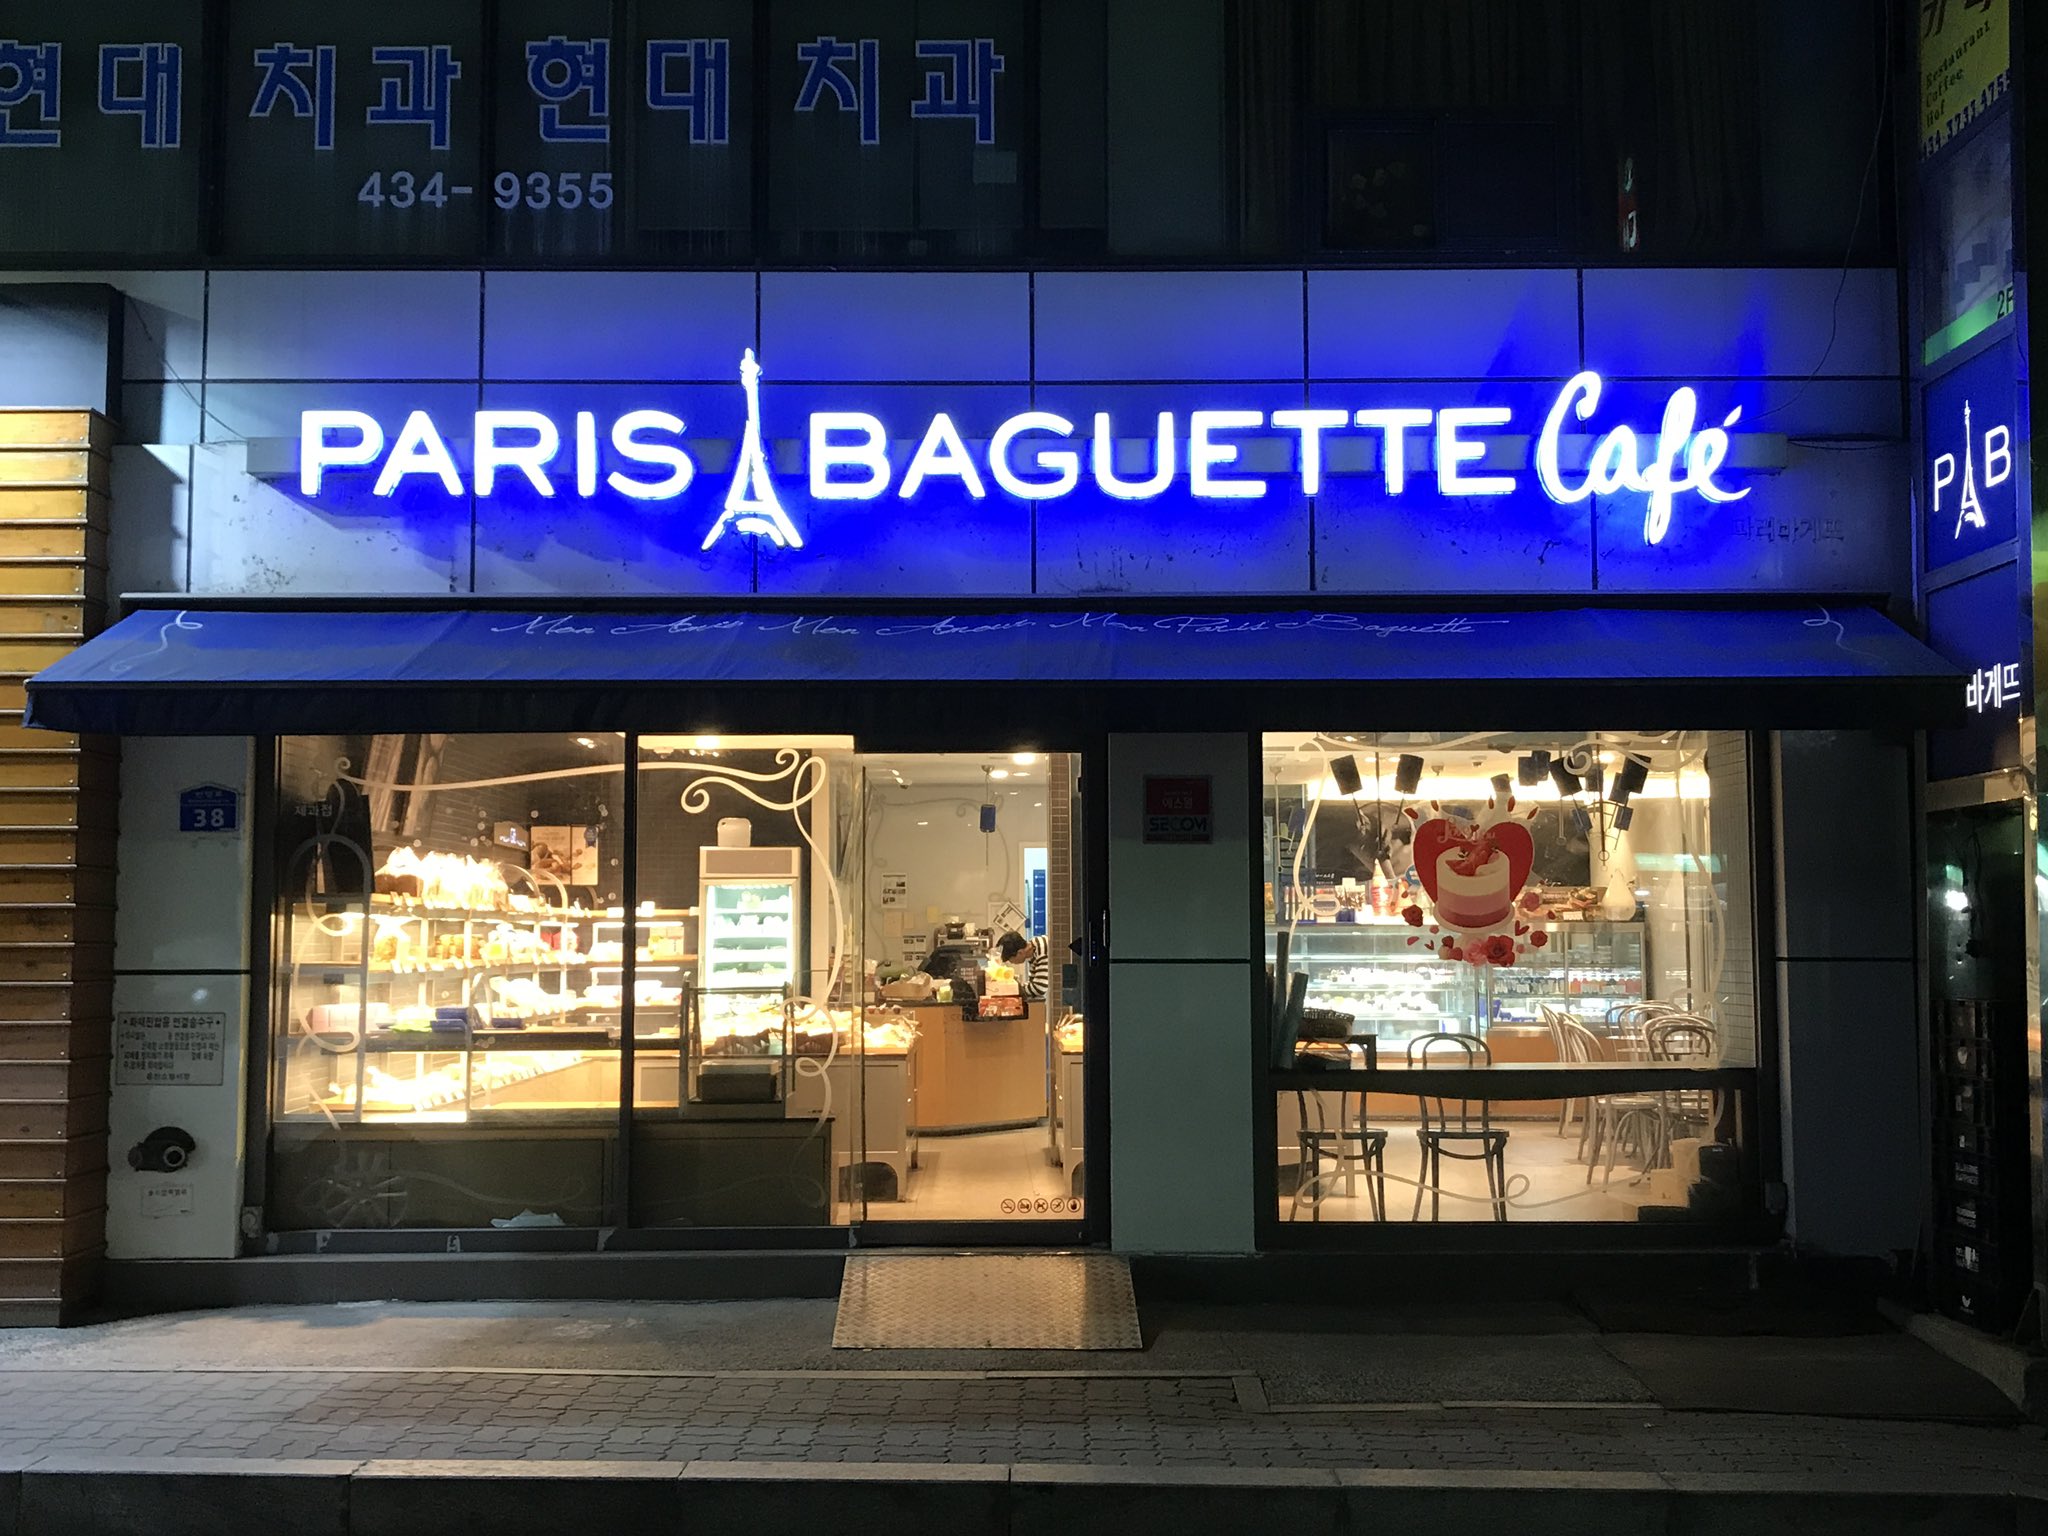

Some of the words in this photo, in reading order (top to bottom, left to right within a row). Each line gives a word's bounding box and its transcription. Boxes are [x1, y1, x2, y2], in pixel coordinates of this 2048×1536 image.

[493, 171, 614, 210] 9355
[299, 409, 695, 498] PARIS
[808, 406, 1517, 501] BAGUETTE
[1535, 370, 1753, 546] Café
[1153, 616, 1270, 634] Paris
[1275, 613, 1510, 638] Baguette
[1965, 662, 2021, 713] 바게뜨
[192, 807, 225, 828] 38
[1150, 816, 1208, 832] SECOM
